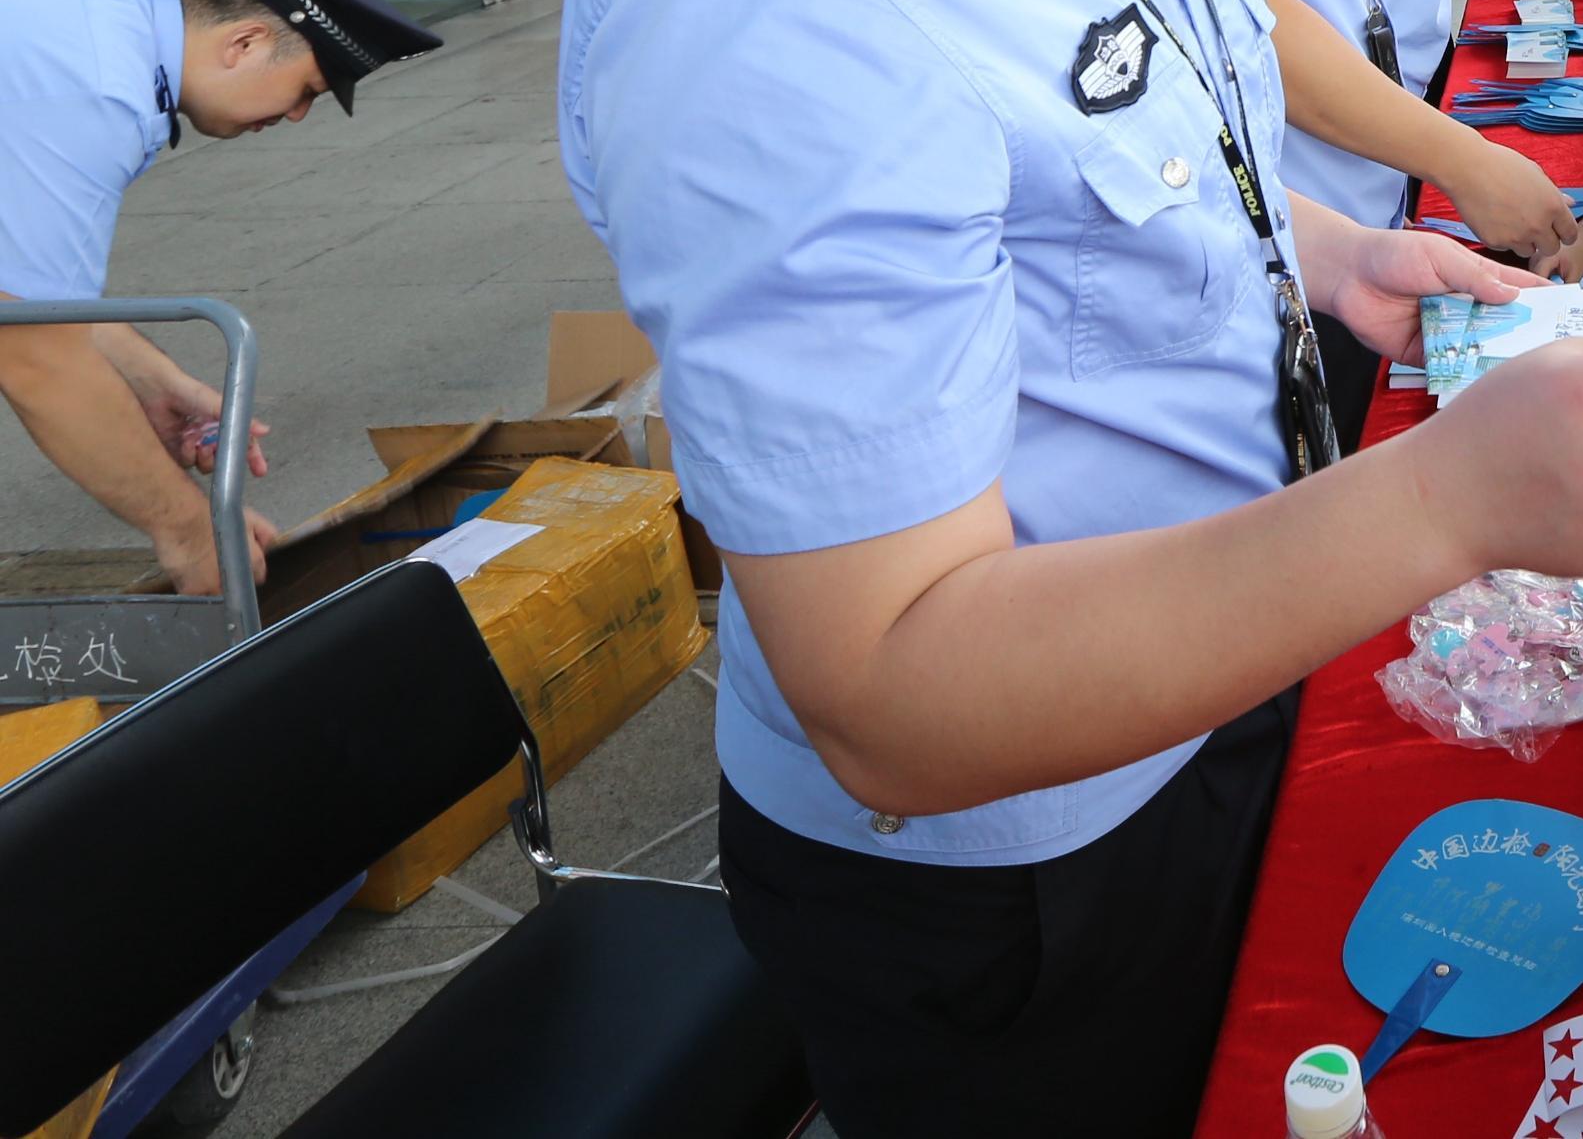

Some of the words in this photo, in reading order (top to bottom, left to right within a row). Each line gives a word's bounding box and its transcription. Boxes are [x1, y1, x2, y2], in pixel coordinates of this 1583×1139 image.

[1232, 163, 1262, 217] POLICE
[0, 632, 139, 686] 检处
[1411, 827, 1532, 871] 中国边检
